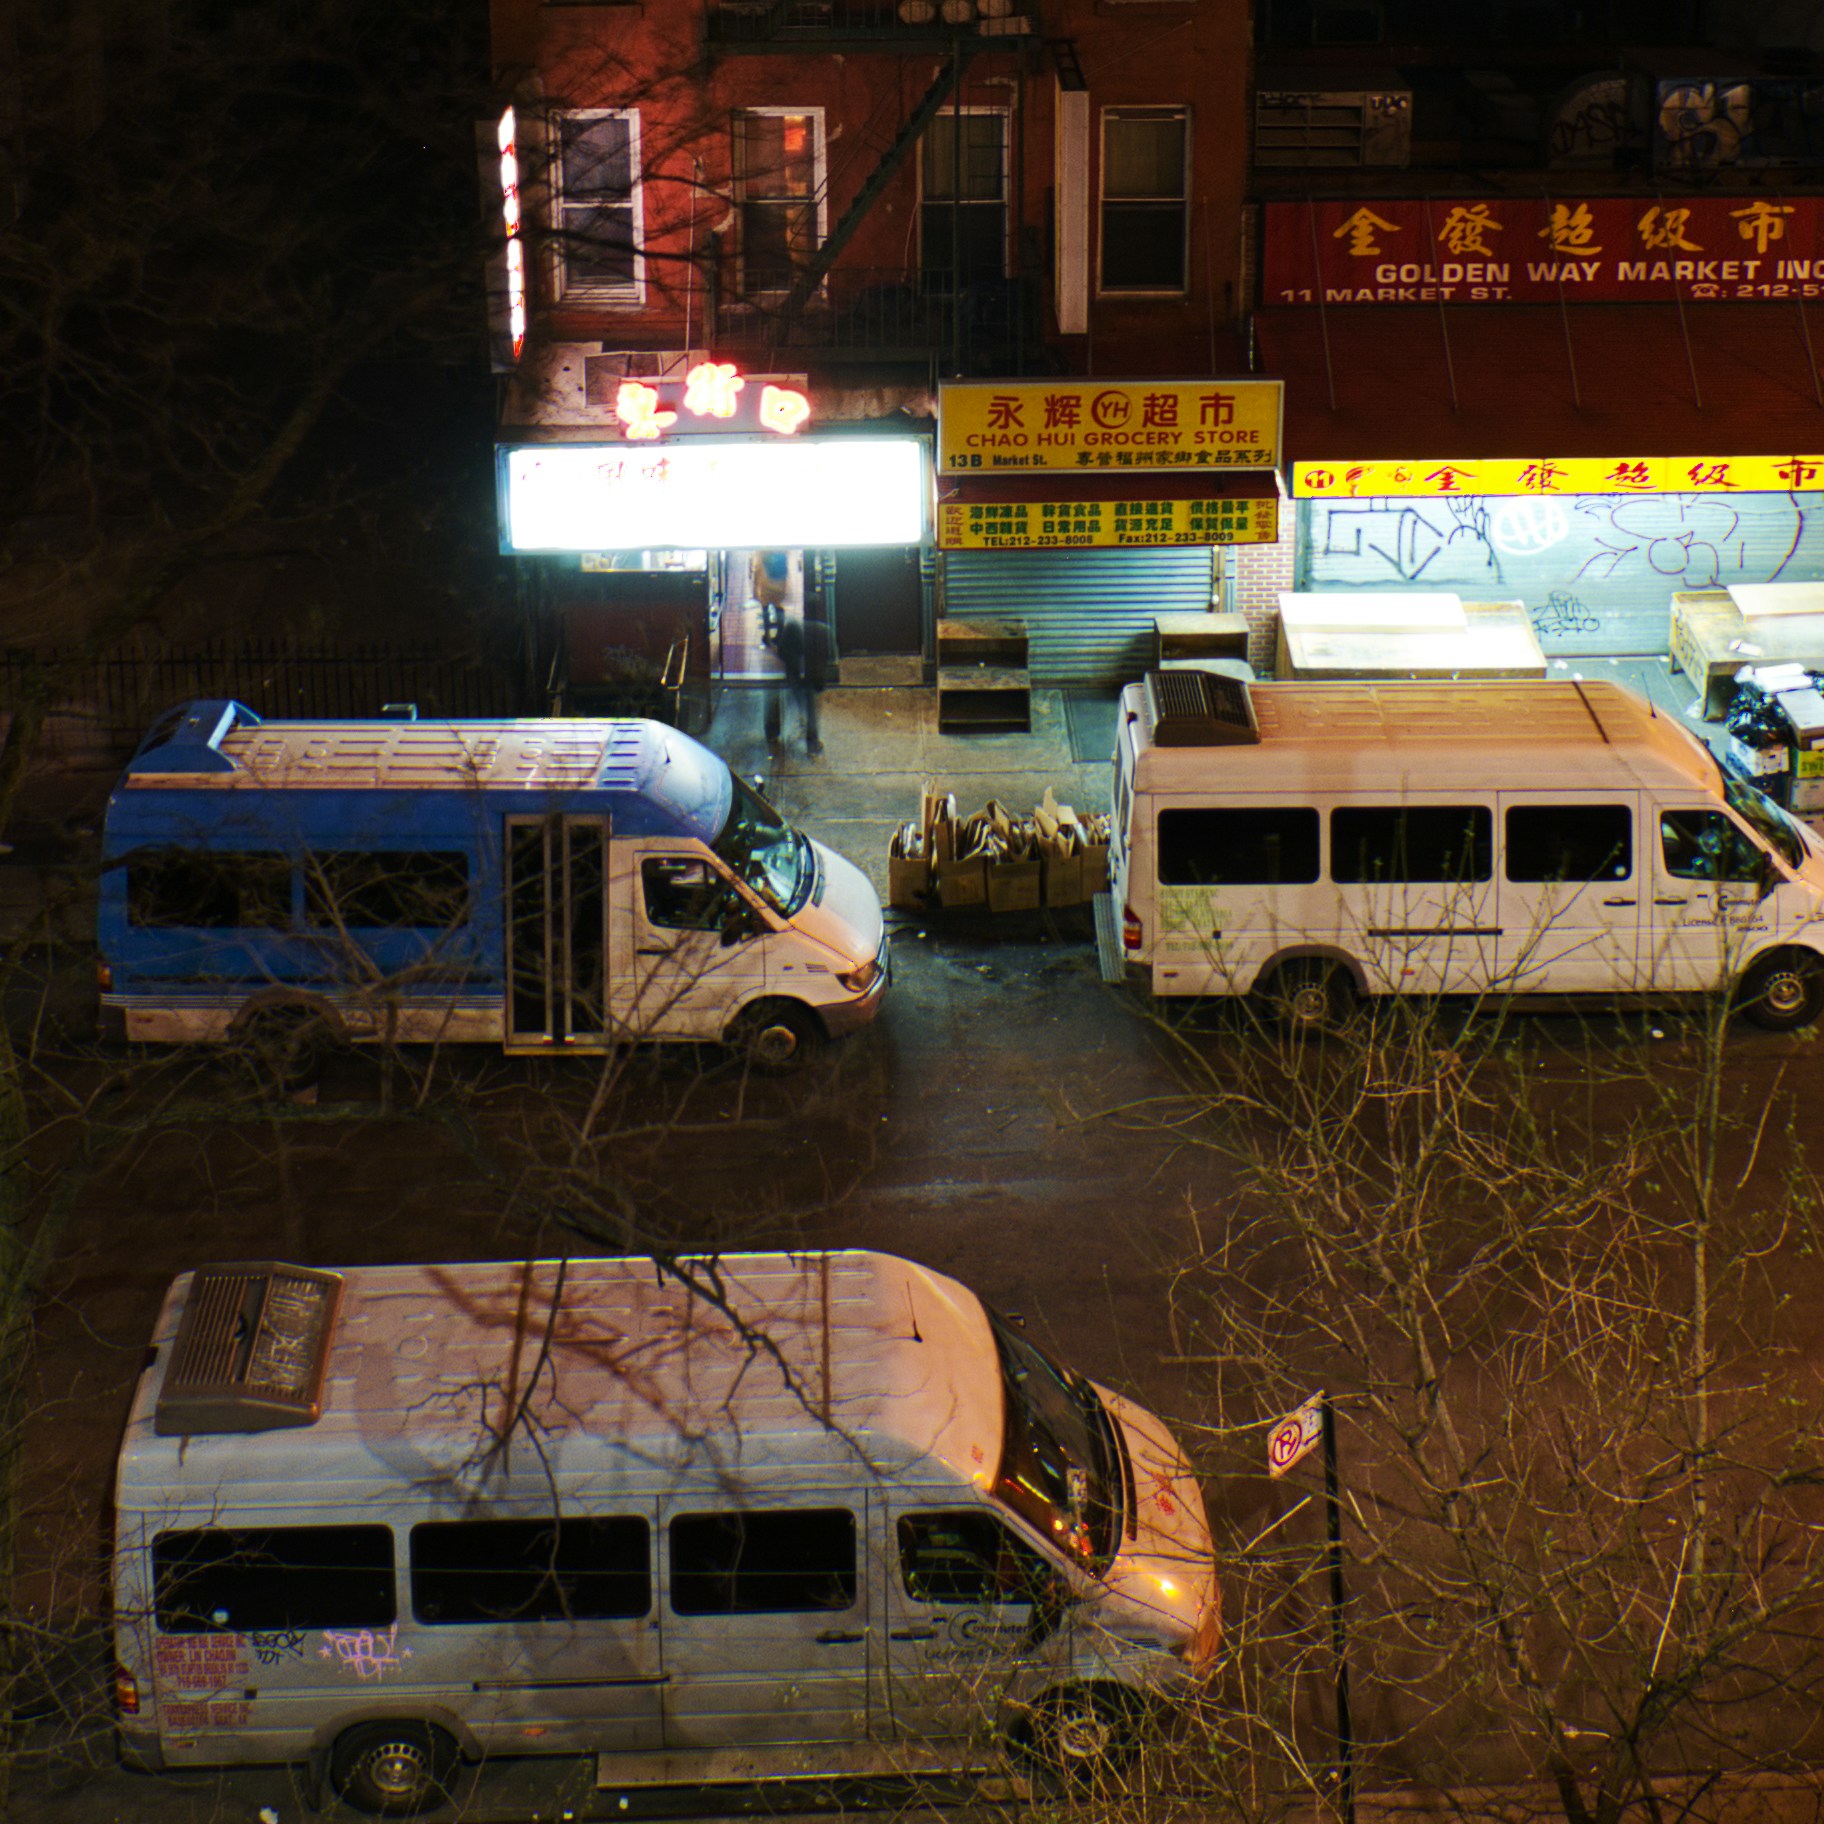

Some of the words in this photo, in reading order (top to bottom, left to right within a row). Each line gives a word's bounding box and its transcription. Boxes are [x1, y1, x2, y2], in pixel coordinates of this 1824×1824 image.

[1376, 263, 1509, 284] GOLDEN
[1527, 262, 1601, 282] WAY
[1618, 261, 1761, 281] MARKET
[1280, 288, 1312, 302] 11
[1326, 288, 1456, 302] MARKET
[1470, 287, 1513, 301] ST.
[966, 432, 1030, 447] CHAO
[1037, 432, 1076, 446] HUI
[1084, 431, 1184, 446] GROCERY
[1194, 430, 1260, 444] STORE
[993, 454, 1030, 466] Market
[1033, 454, 1048, 466] St.
